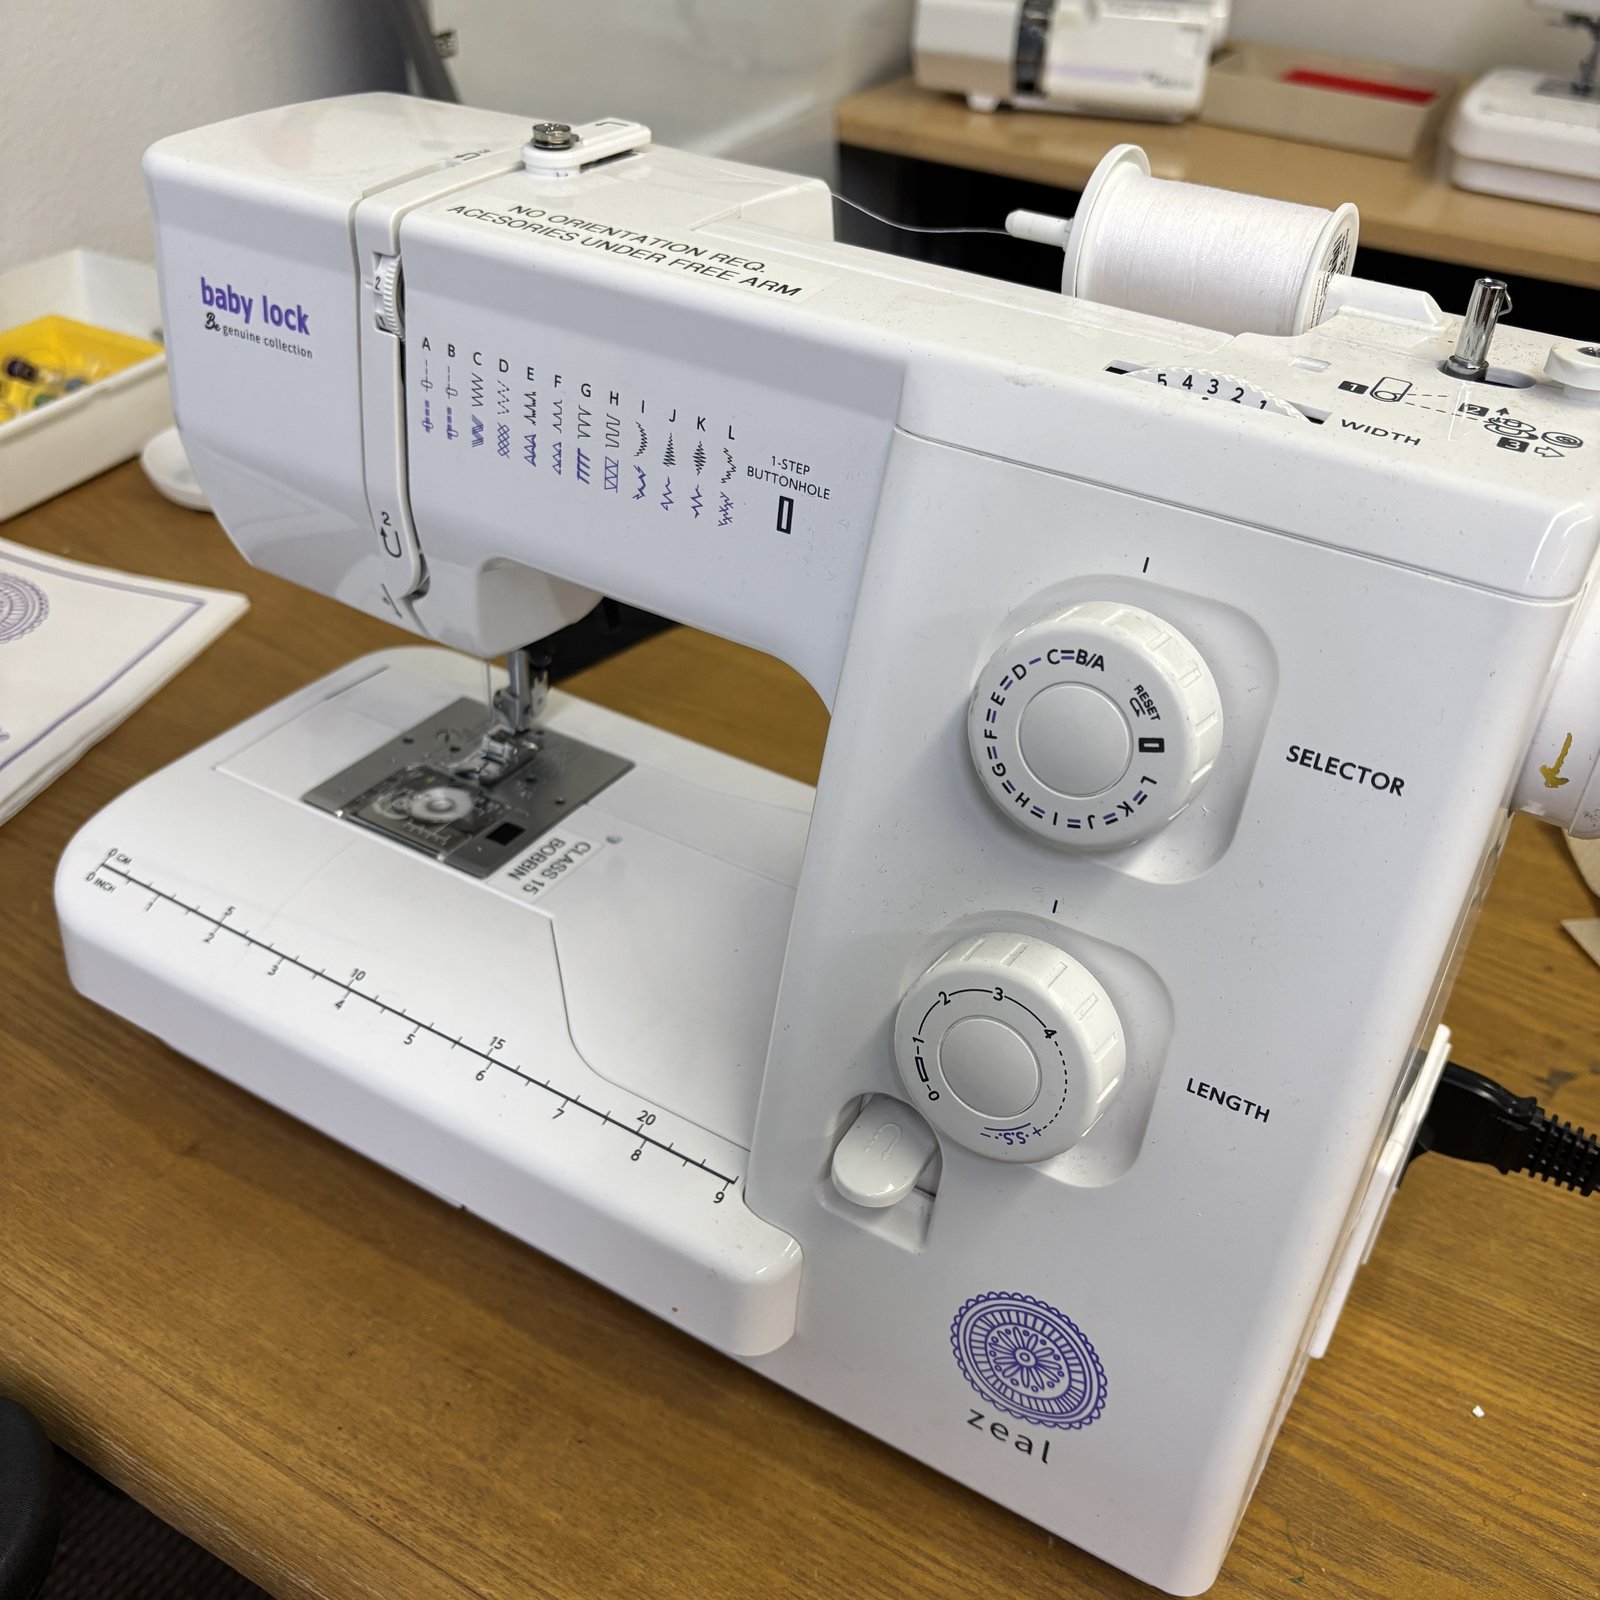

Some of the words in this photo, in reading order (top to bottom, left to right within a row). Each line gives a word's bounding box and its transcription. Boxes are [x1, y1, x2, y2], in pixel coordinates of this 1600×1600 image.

[508, 205, 546, 219] NO
[548, 214, 708, 257] ORIENTATION
[709, 252, 767, 274] REQ.
[447, 205, 580, 242] ACESORIES
[581, 237, 667, 264] UNDER
[668, 258, 740, 281] FREE
[739, 276, 802, 297] ARM
[375, 276, 381, 291] 2
[201, 276, 253, 324] baby
[262, 295, 310, 336] lock
[205, 312, 221, 332] Be
[223, 325, 261, 344] genuine
[264, 337, 313, 359] collection
[422, 337, 431, 351] A
[447, 344, 455, 358] B
[472, 352, 482, 366] C
[499, 359, 509, 373] D
[527, 367, 534, 381] E
[554, 374, 562, 388] F
[581, 383, 591, 398] G
[1157, 373, 1168, 386] 5
[1182, 374, 1193, 390] 4
[1206, 378, 1219, 394] 3
[1230, 387, 1244, 404] 2
[1259, 400, 1267, 410] 1
[609, 391, 619, 406] H
[669, 409, 676, 423] J
[696, 416, 706, 431] K
[728, 425, 735, 440] L
[1341, 419, 1421, 447] WIDTH
[771, 455, 811, 474] 1-STEP
[746, 465, 831, 500] BUTTONHOLE
[381, 511, 391, 526] 2
[1011, 663, 1027, 680] D
[990, 691, 1006, 707] E
[1133, 684, 1161, 722] RESET
[984, 729, 997, 740] F
[991, 762, 1006, 777] G
[1286, 745, 1405, 797] SELECTOR
[1140, 775, 1157, 785] L
[1015, 792, 1030, 808] H
[1117, 800, 1134, 817] K
[1087, 815, 1095, 830] J
[108, 848, 118, 858] 0
[116, 853, 132, 865] CM
[507, 838, 567, 881] BOBBIN
[541, 841, 592, 880] CLASS
[86, 871, 96, 881] 0
[94, 878, 116, 893] INCH
[522, 879, 545, 895] 15
[224, 906, 236, 917] 5
[203, 932, 215, 944] 2
[267, 964, 279, 976] 3
[351, 967, 366, 982] 10
[938, 991, 951, 1006] 2
[992, 987, 1004, 1001] 3
[334, 999, 345, 1010] 4
[403, 1034, 415, 1046] 5
[1043, 1027, 1057, 1039] 4
[489, 1035, 506, 1051] 15
[912, 1036, 925, 1046] 1
[475, 1069, 485, 1082] 6
[928, 1090, 940, 1101] 0
[1186, 1077, 1270, 1123] LENGTH
[552, 1108, 565, 1121] 7
[636, 1110, 657, 1126] 20
[630, 1149, 643, 1162] 8
[713, 1190, 725, 1205] 9
[967, 1409, 1050, 1464] zeal
